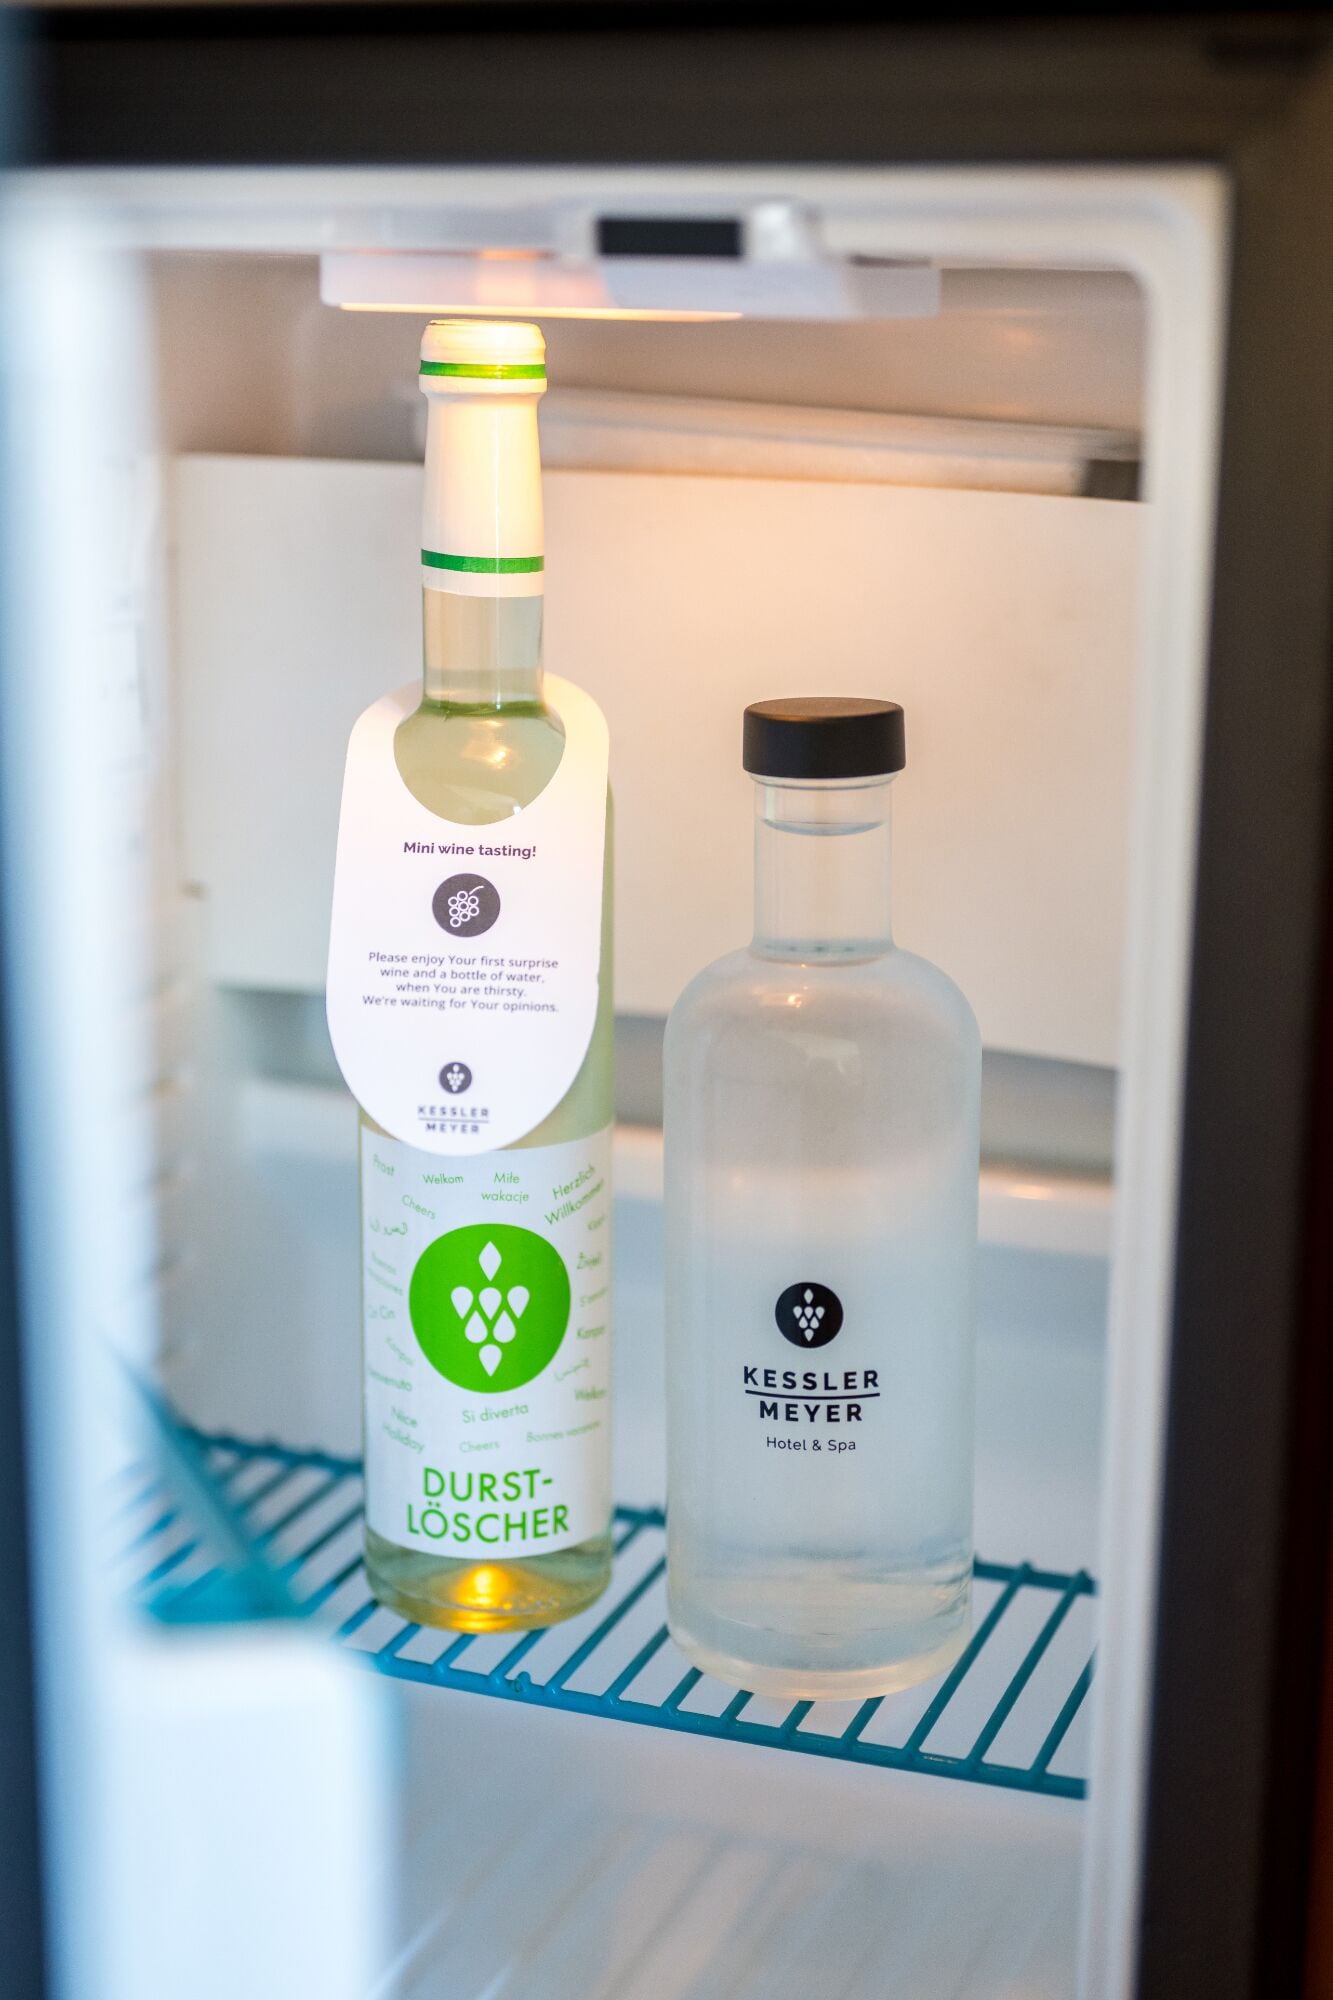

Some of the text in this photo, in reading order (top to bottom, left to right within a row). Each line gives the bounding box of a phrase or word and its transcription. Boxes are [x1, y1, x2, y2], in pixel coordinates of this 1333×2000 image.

[403, 841, 537, 860] Mini wine tasting!
[368, 951, 559, 970] Please enjoy Your first surprise
[380, 967, 409, 978] wine
[412, 968, 437, 979] and
[440, 971, 447, 979] a
[450, 969, 487, 981] bottle
[490, 970, 503, 981] of
[396, 982, 527, 998] when You are thirsty.
[362, 995, 560, 1013] We're waiting for Your opinions.
[418, 1105, 490, 1118] KESSLER
[425, 1122, 480, 1134] MEYER
[422, 1172, 464, 1185] Welkom
[552, 1162, 597, 1200] Herzlich
[401, 1193, 436, 1220] Cheers
[480, 1190, 529, 1204] wakacje
[743, 1365, 879, 1391] KESSLER
[462, 1403, 529, 1424] Si diverta
[759, 1400, 862, 1423] MEYER
[766, 1436, 856, 1453] Hotel & Spa
[423, 1466, 554, 1502] DURST-
[407, 1501, 570, 1544] LÖSCHER
